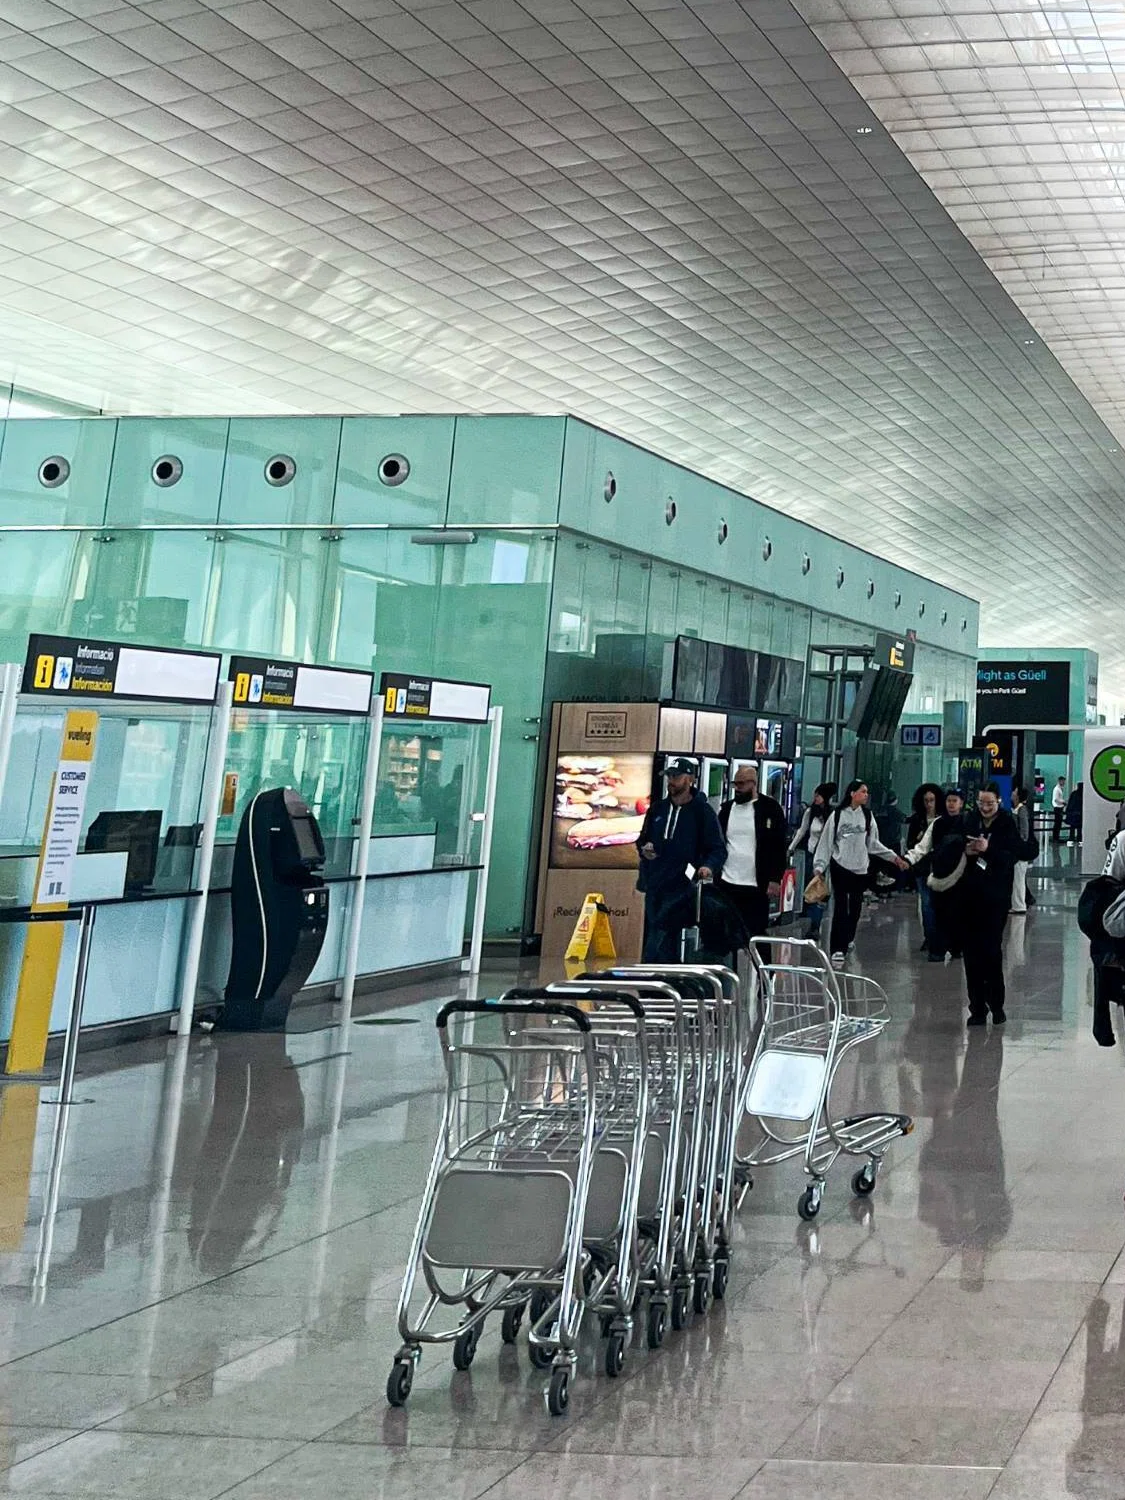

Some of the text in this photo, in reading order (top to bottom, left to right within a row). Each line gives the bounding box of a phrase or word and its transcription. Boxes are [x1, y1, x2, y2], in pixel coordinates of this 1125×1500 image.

[77, 644, 114, 661] Informació
[1003, 672, 1016, 680] as
[1017, 669, 1047, 681] Güell
[71, 676, 113, 692] Información
[68, 726, 92, 746] vueling
[960, 758, 982, 770] ATM
[61, 771, 87, 781] CUSTOMER
[58, 785, 79, 795] SERVICE
